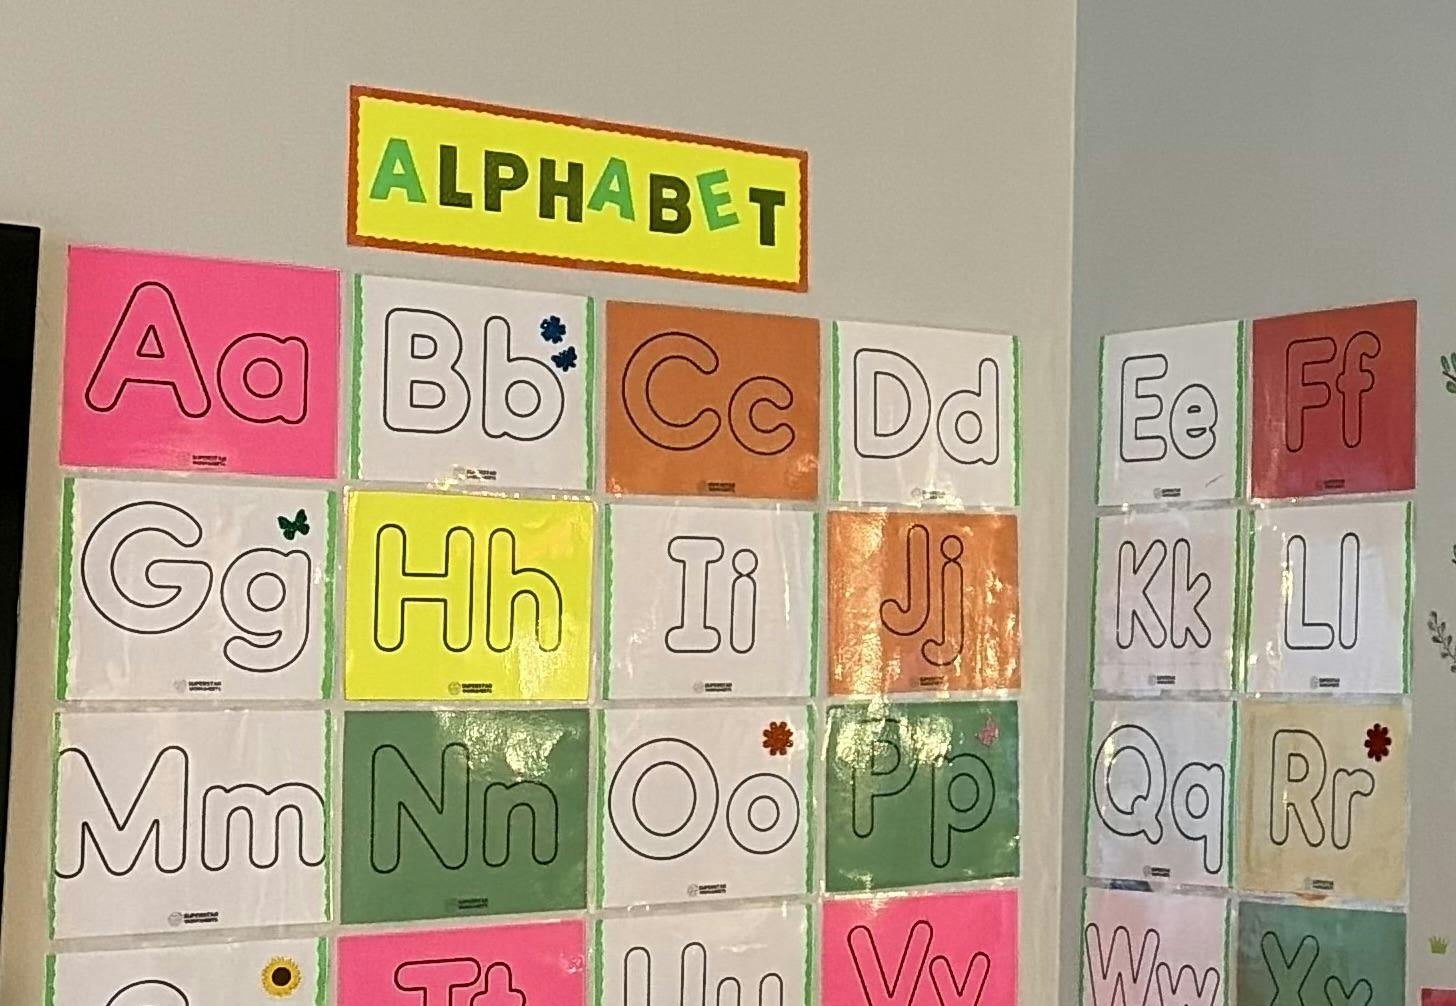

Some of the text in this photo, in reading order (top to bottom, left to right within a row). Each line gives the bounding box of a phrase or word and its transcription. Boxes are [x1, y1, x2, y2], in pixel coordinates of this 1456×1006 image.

[369, 137, 786, 247] ALPHABET
[85, 281, 308, 424] Aa
[383, 307, 565, 441] Bb
[621, 331, 795, 456] Cc
[853, 347, 1000, 465] Dd
[1119, 353, 1219, 463] Ee
[1285, 330, 1382, 453] Ff
[80, 501, 311, 673] Gg
[374, 523, 563, 652] Hh
[664, 535, 758, 654] Ii
[879, 523, 965, 667] Jj
[1116, 537, 1212, 650] Kk
[54, 745, 326, 879] Mm
[370, 742, 558, 874] Nn
[608, 737, 800, 861] Oo
[851, 718, 996, 869] Pp
[1093, 723, 1225, 875] Qq
[1270, 729, 1375, 850] Rr
